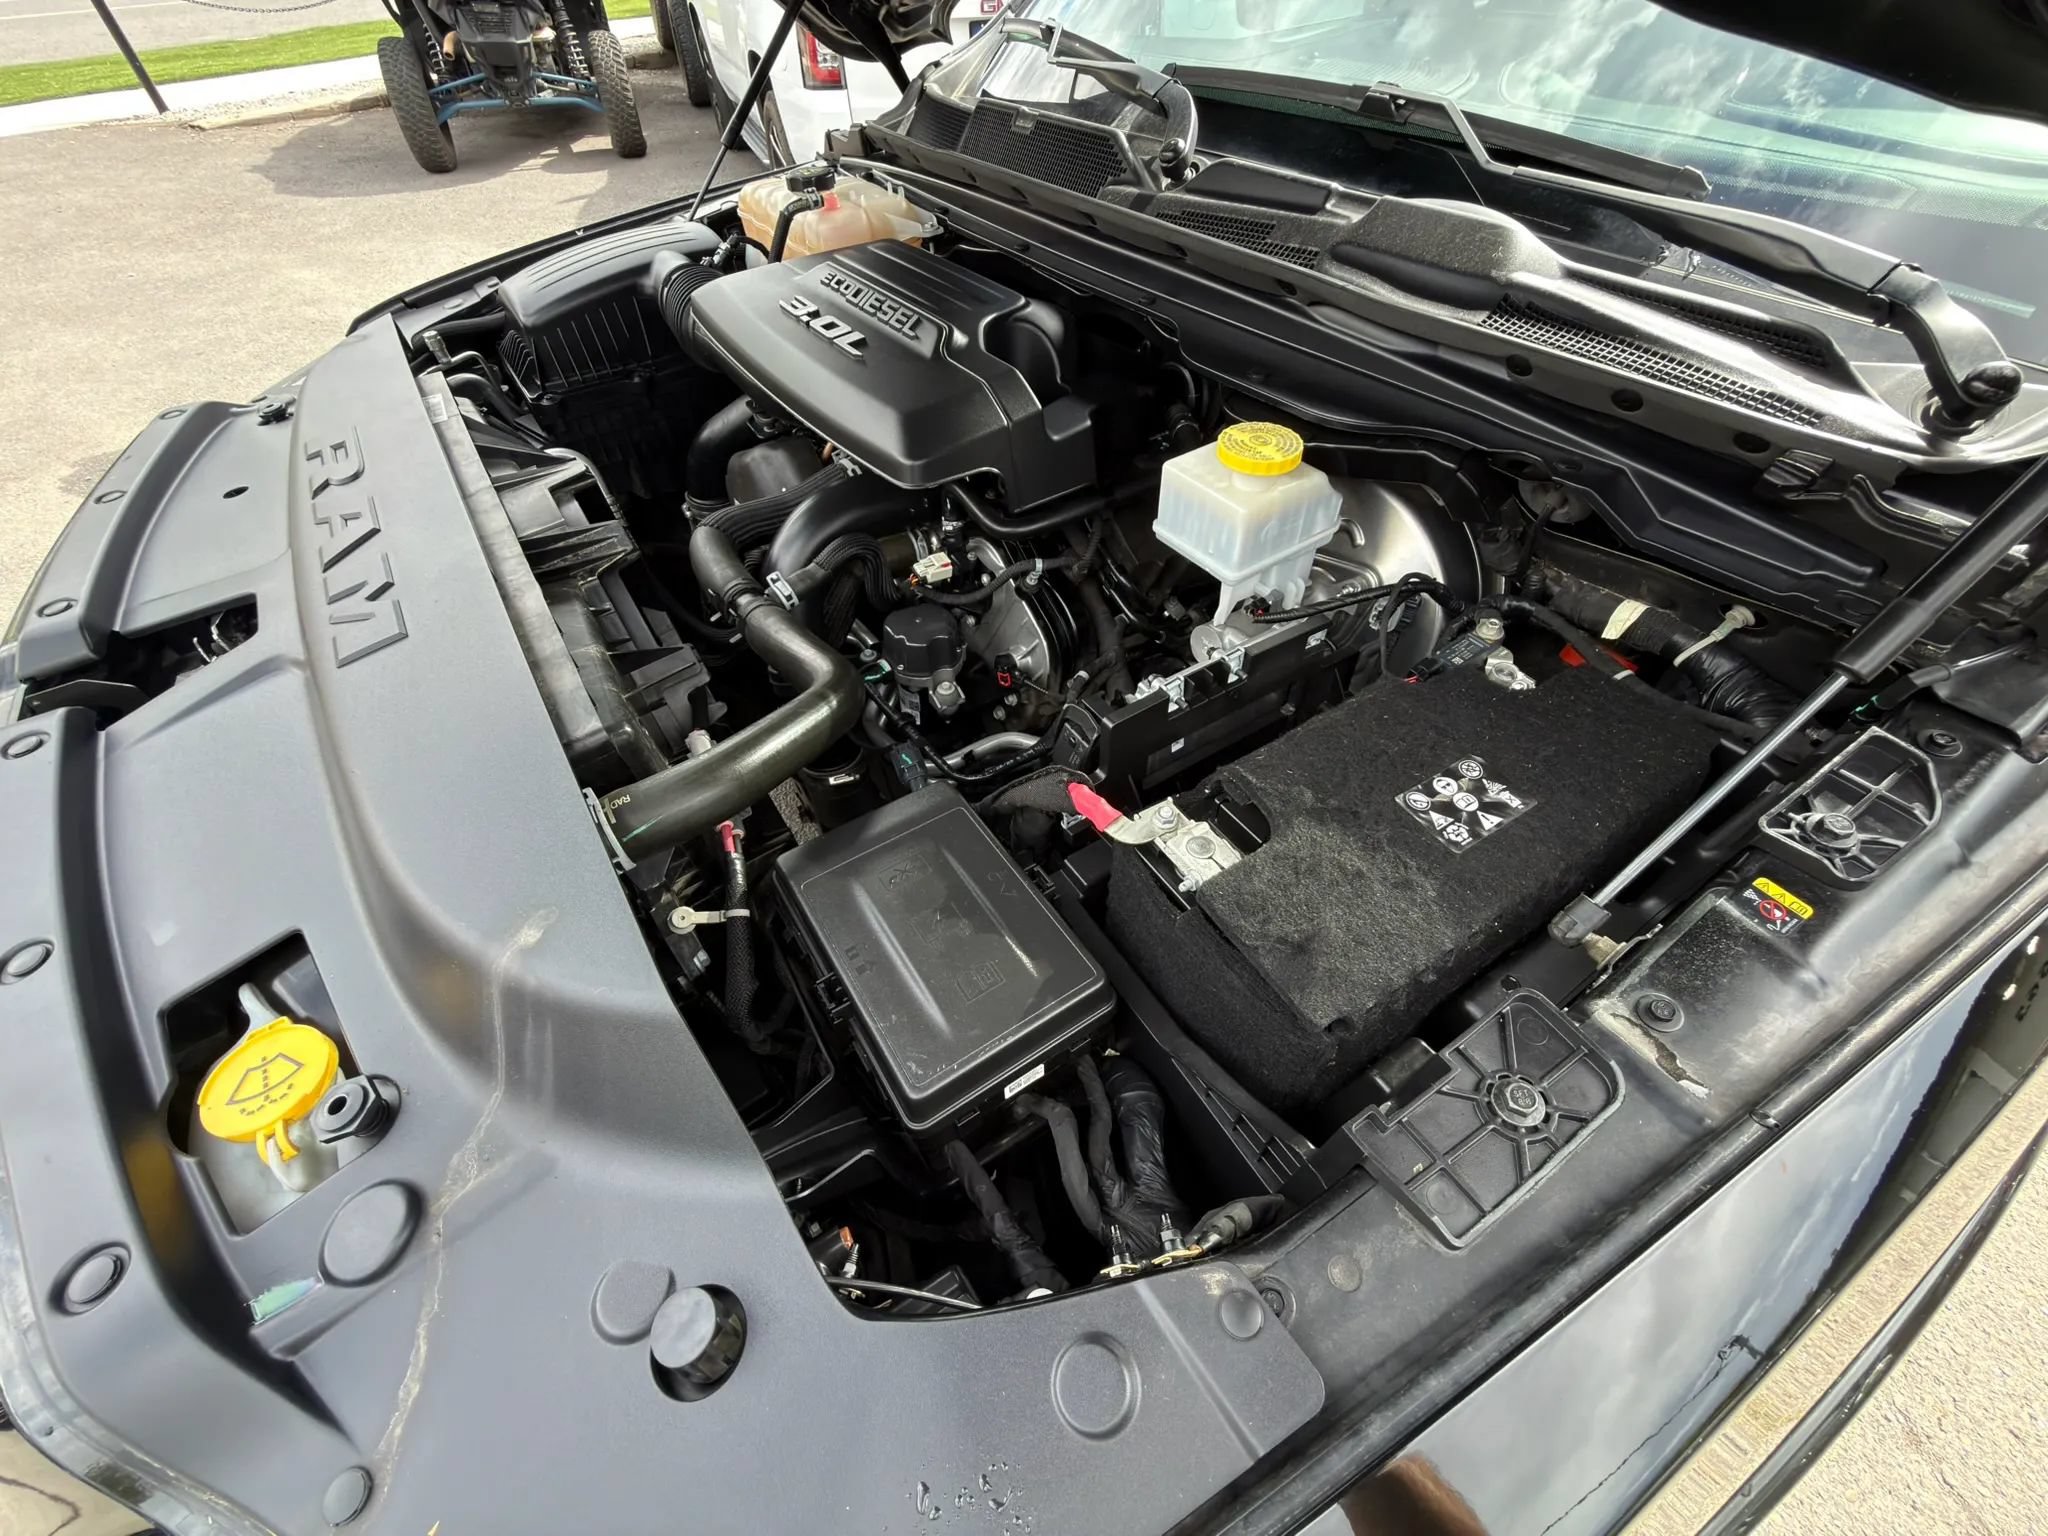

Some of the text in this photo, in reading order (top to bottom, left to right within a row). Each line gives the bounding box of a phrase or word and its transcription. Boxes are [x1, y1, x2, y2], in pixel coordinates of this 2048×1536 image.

[778, 294, 867, 360] 3.0L
[820, 271, 919, 340] ECODIESEL
[304, 425, 409, 669] RAM
